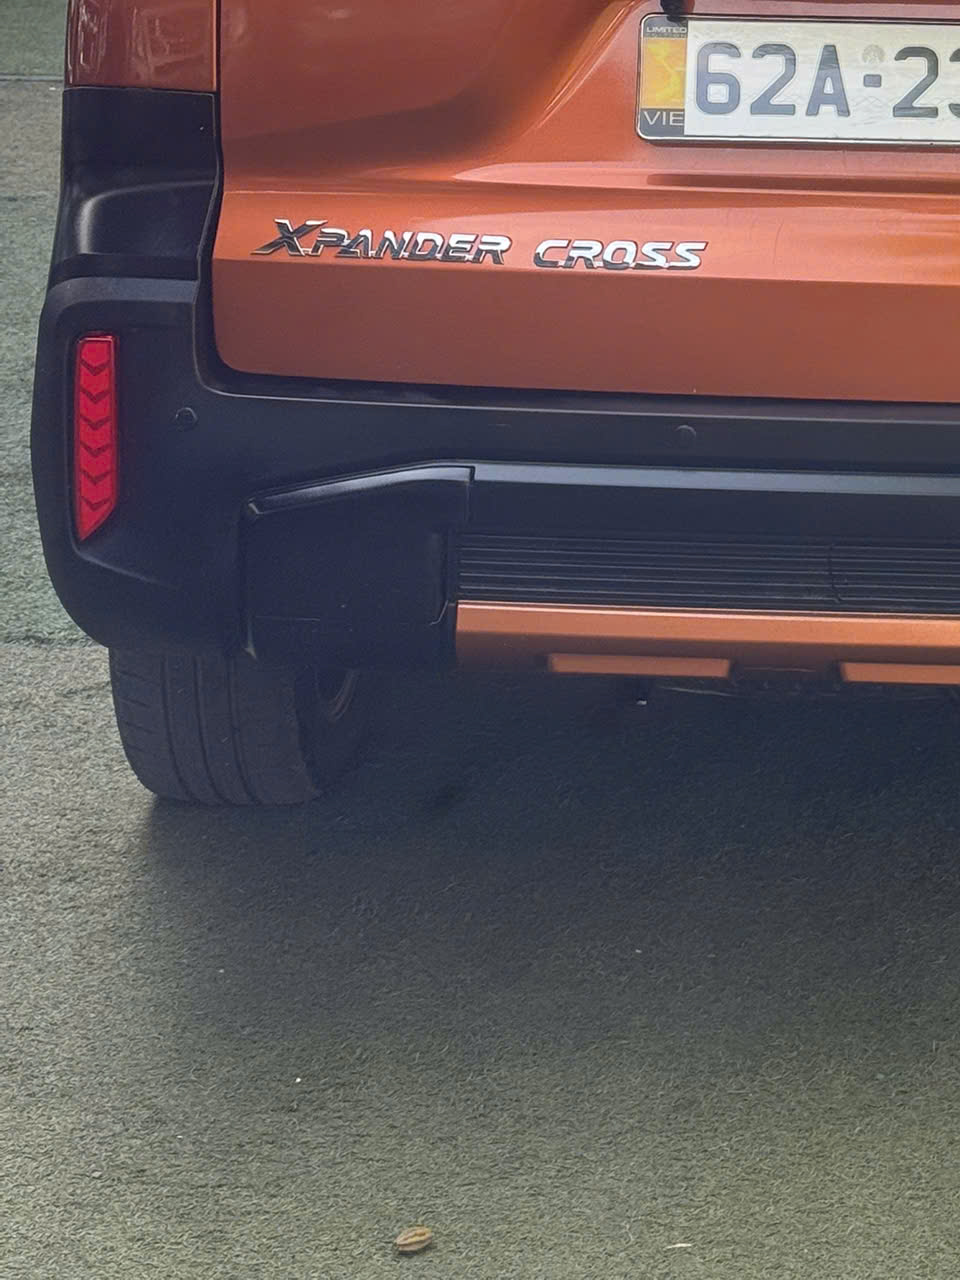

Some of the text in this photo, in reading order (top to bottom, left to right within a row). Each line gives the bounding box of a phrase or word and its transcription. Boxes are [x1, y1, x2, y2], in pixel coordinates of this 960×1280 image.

[646, 25, 687, 34] LIMITED
[249, 218, 709, 271] XPANDER CROSS
